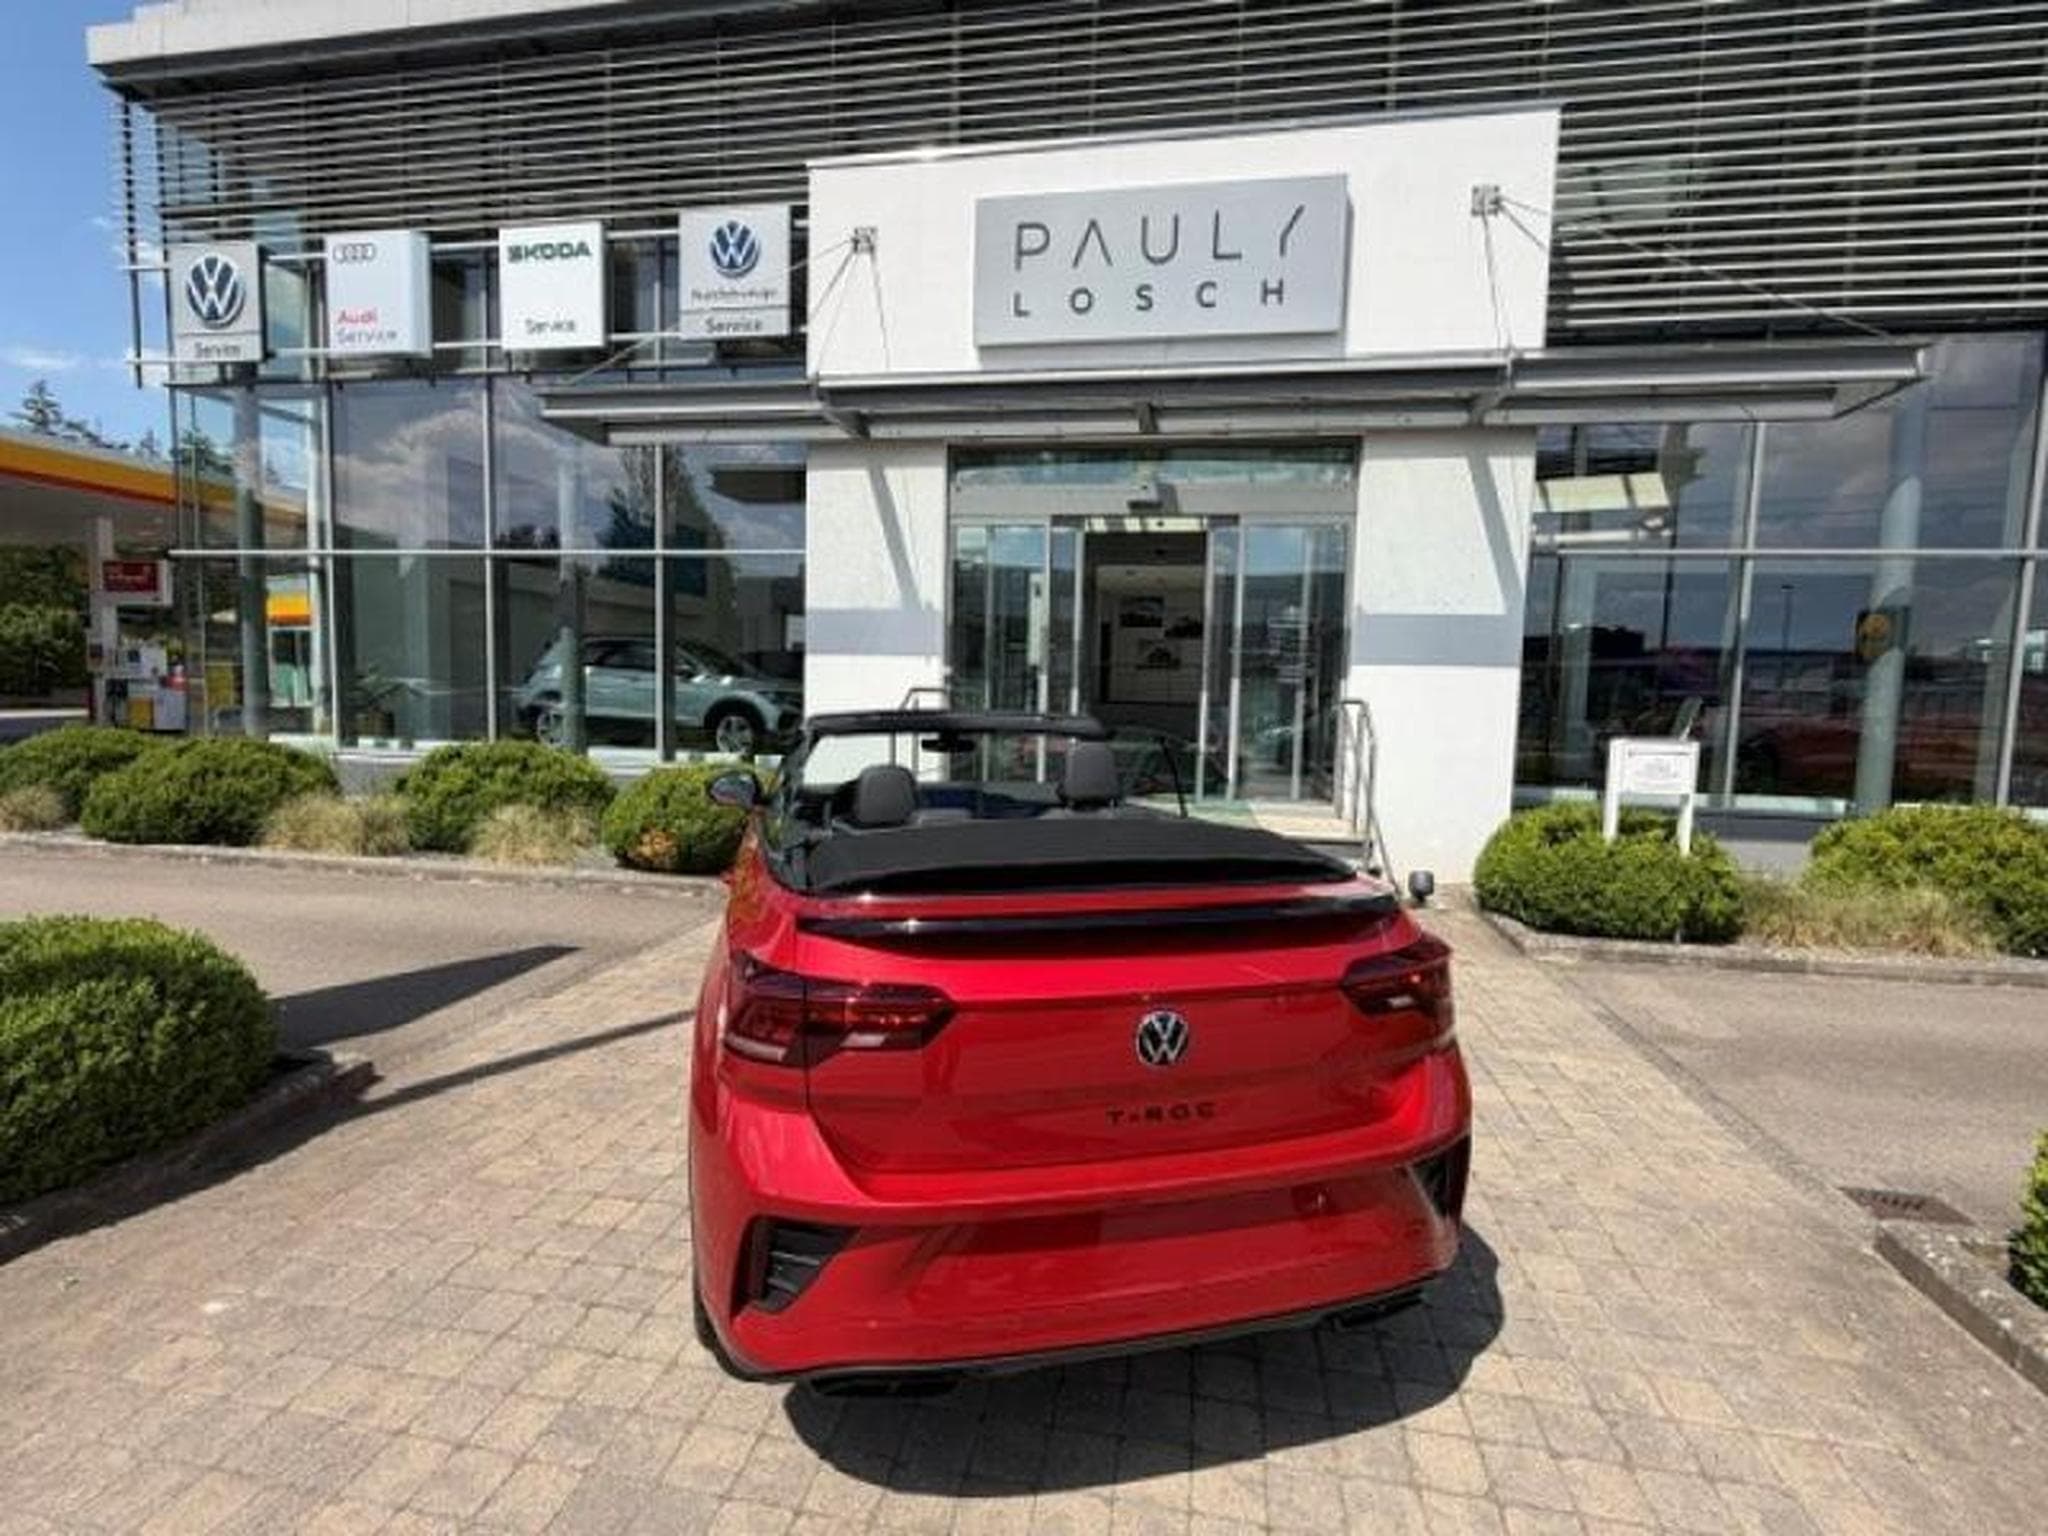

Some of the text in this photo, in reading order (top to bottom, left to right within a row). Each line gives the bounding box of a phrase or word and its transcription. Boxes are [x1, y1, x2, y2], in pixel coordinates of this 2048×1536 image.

[1013, 204, 1305, 272] PAULY
[1012, 277, 1285, 317] LOSCH
[337, 307, 378, 324] Audi
[524, 317, 576, 335] Service
[336, 327, 399, 344] Service
[1105, 1101, 1217, 1126] T-ROC
